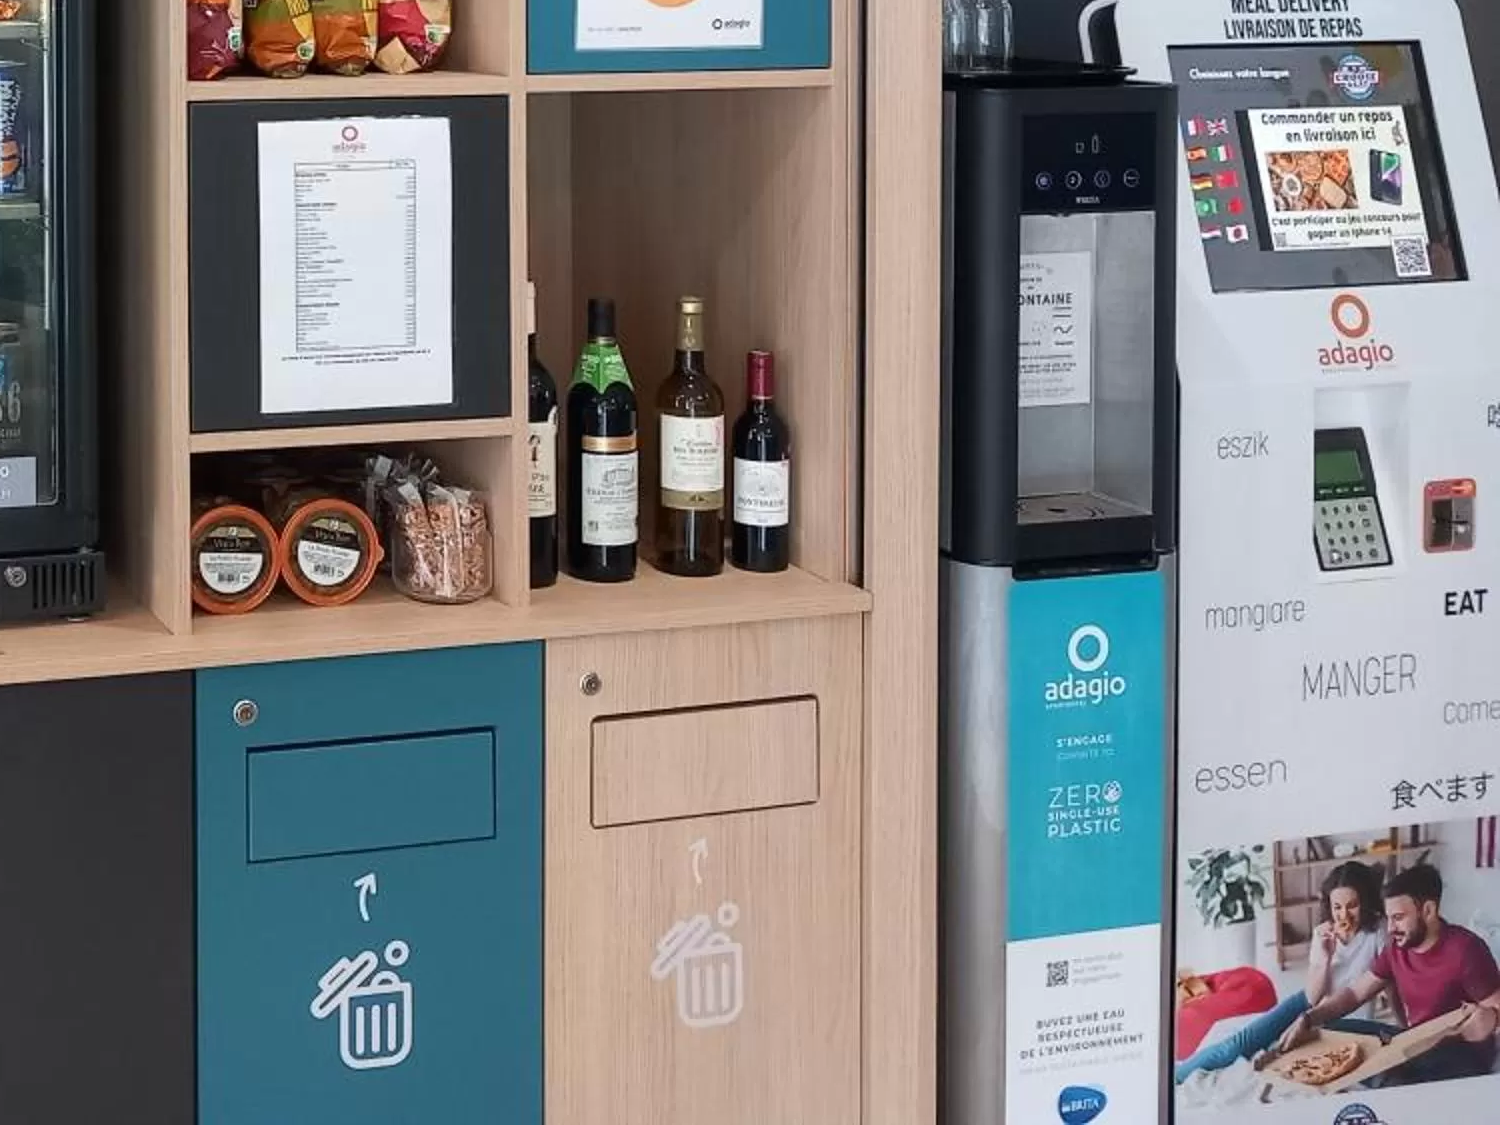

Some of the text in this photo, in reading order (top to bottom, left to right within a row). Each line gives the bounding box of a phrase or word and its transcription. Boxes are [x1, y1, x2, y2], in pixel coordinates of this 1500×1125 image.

[1224, 17, 1363, 39] LIVRAISON DE REPAS
[1261, 111, 1393, 125] Commander un repas
[1286, 127, 1376, 142] en livraison ici
[1318, 340, 1394, 370] adagio
[1216, 431, 1270, 460] eszik
[1204, 597, 1307, 632] mangiare
[1444, 588, 1488, 617] EAT
[1045, 671, 1126, 704] adagio
[1302, 654, 1417, 702] MANGER
[1194, 759, 1288, 793] essen
[1391, 772, 1496, 811] 食べます
[1048, 818, 1121, 838] PLASTIC
[1036, 1008, 1125, 1030] BUVEZ UNE EAU
[1037, 1022, 1123, 1043] RESPECTUEUSE
[1020, 1033, 1144, 1060] DE L'ENVIRONNEMENT
